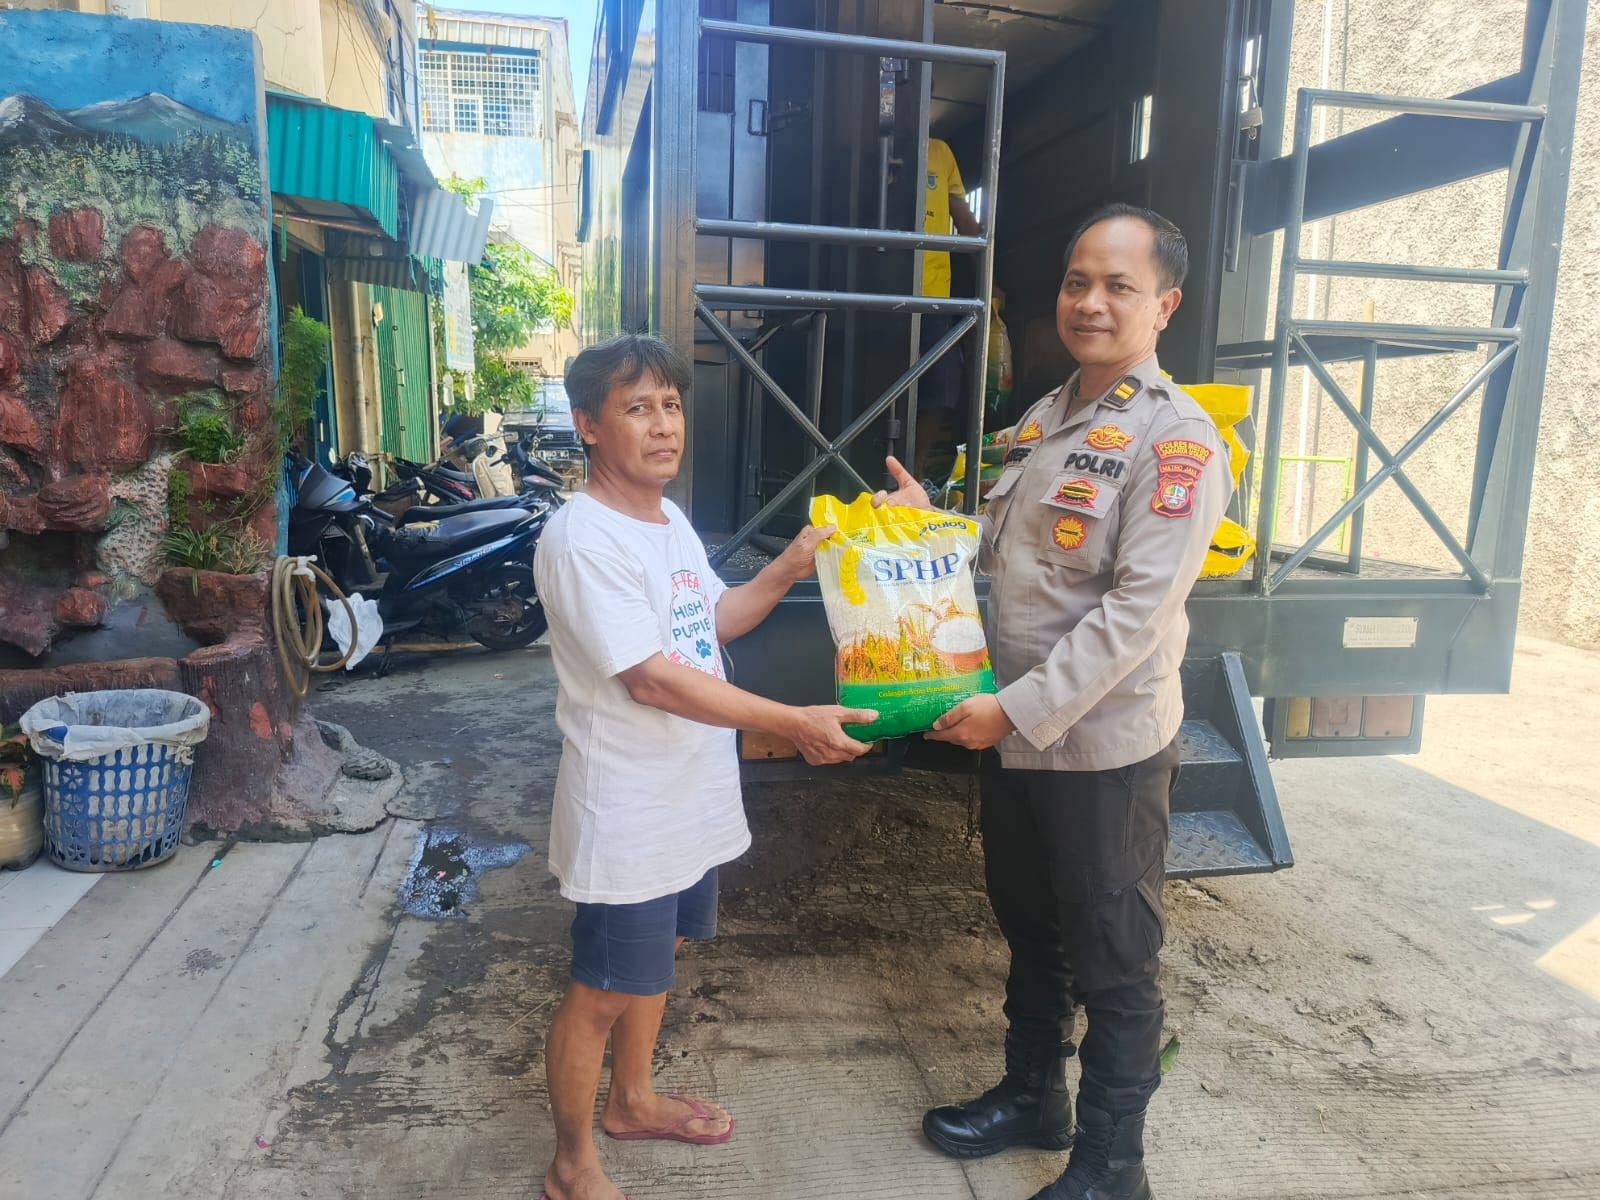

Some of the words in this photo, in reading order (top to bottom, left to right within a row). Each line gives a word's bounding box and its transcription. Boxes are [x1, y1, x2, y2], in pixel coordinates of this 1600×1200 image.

[1064, 452, 1125, 479] POLRI
[928, 521, 967, 532] bulog
[873, 552, 960, 581] SPHP
